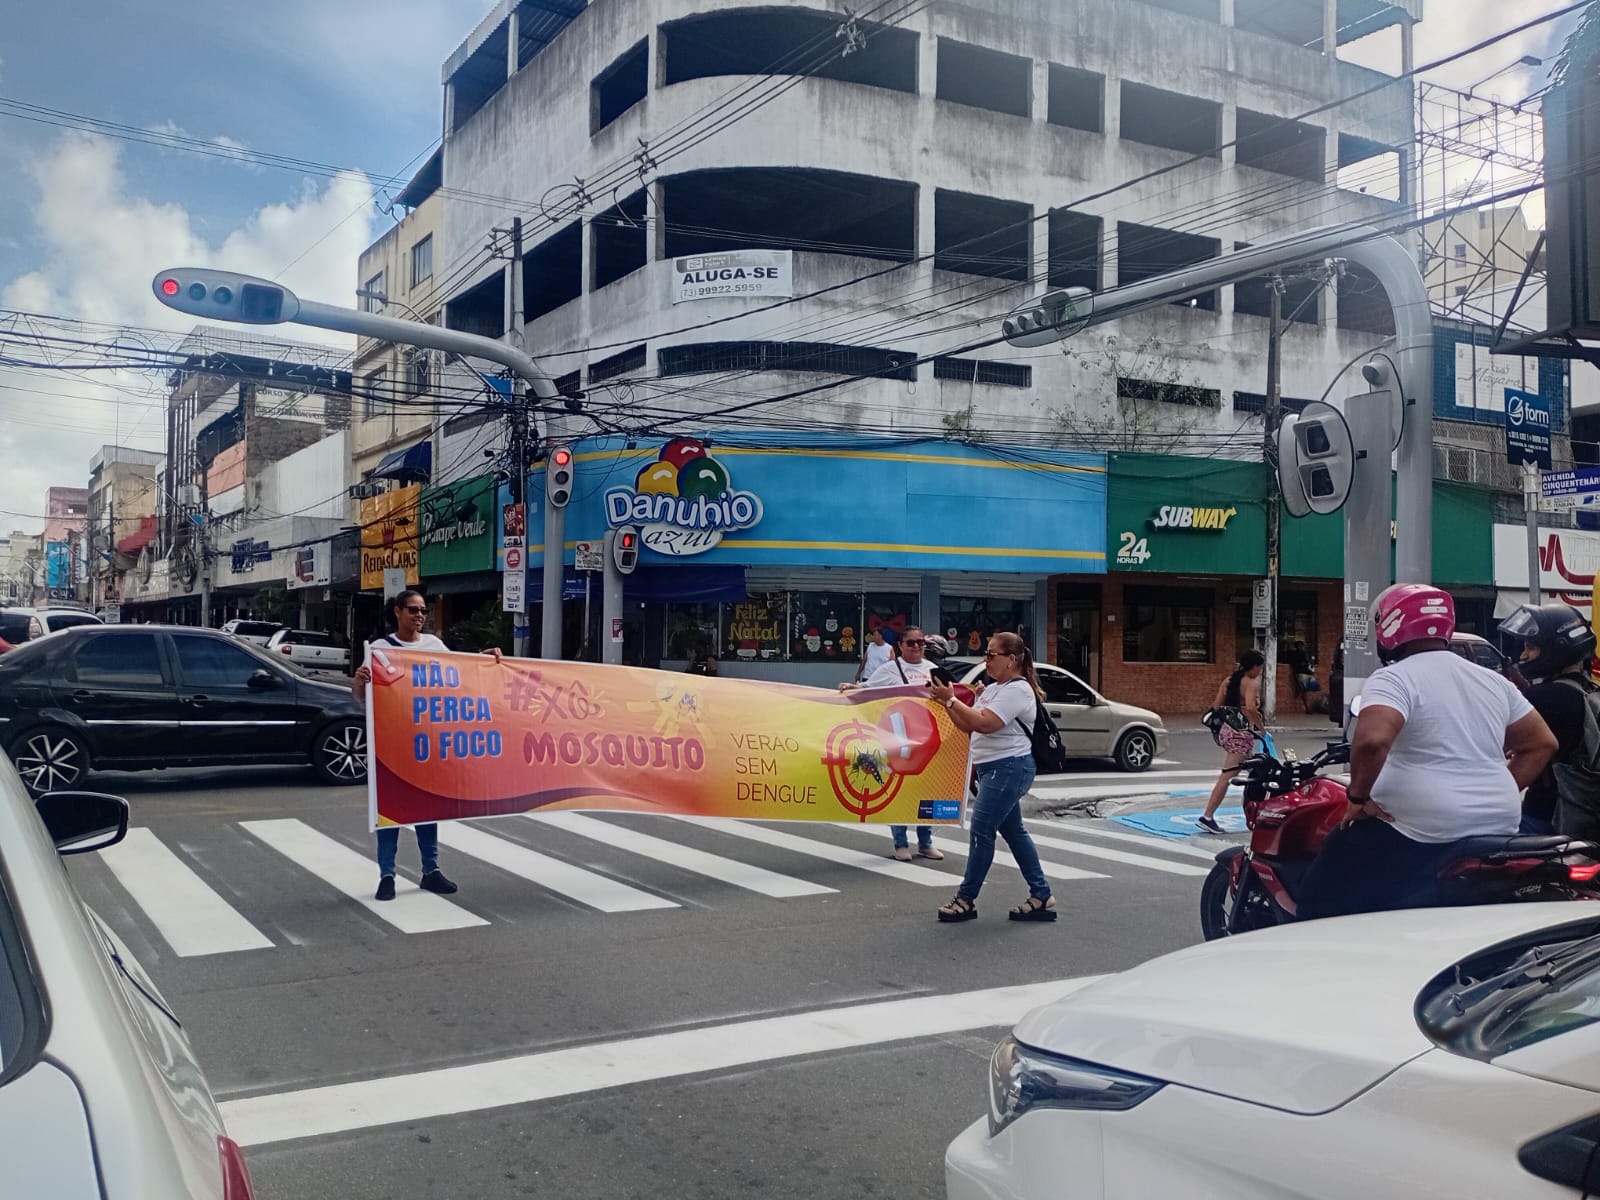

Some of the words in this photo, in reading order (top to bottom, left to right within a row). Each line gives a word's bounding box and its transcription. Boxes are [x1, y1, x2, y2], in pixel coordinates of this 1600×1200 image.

[682, 266, 779, 285] ALUGA-SE
[1524, 402, 1550, 425] form
[1542, 472, 1576, 483] AVENIDA
[1542, 476, 1600, 491] CINQUENTENÁR
[607, 491, 753, 529] Danubio
[1152, 505, 1238, 530] SUBWAY
[644, 524, 715, 555] azul
[1117, 531, 1152, 565] 24
[1116, 557, 1139, 565] HORAS
[735, 603, 769, 620] Feliz
[728, 620, 781, 640] Natal
[411, 659, 460, 689] NÃO
[412, 695, 493, 724] PERCA
[414, 732, 430, 762] O
[440, 730, 502, 760] FOCO
[523, 730, 706, 771] MOSQUITO
[735, 756, 778, 776] SEM
[736, 781, 818, 805] DENGUE
